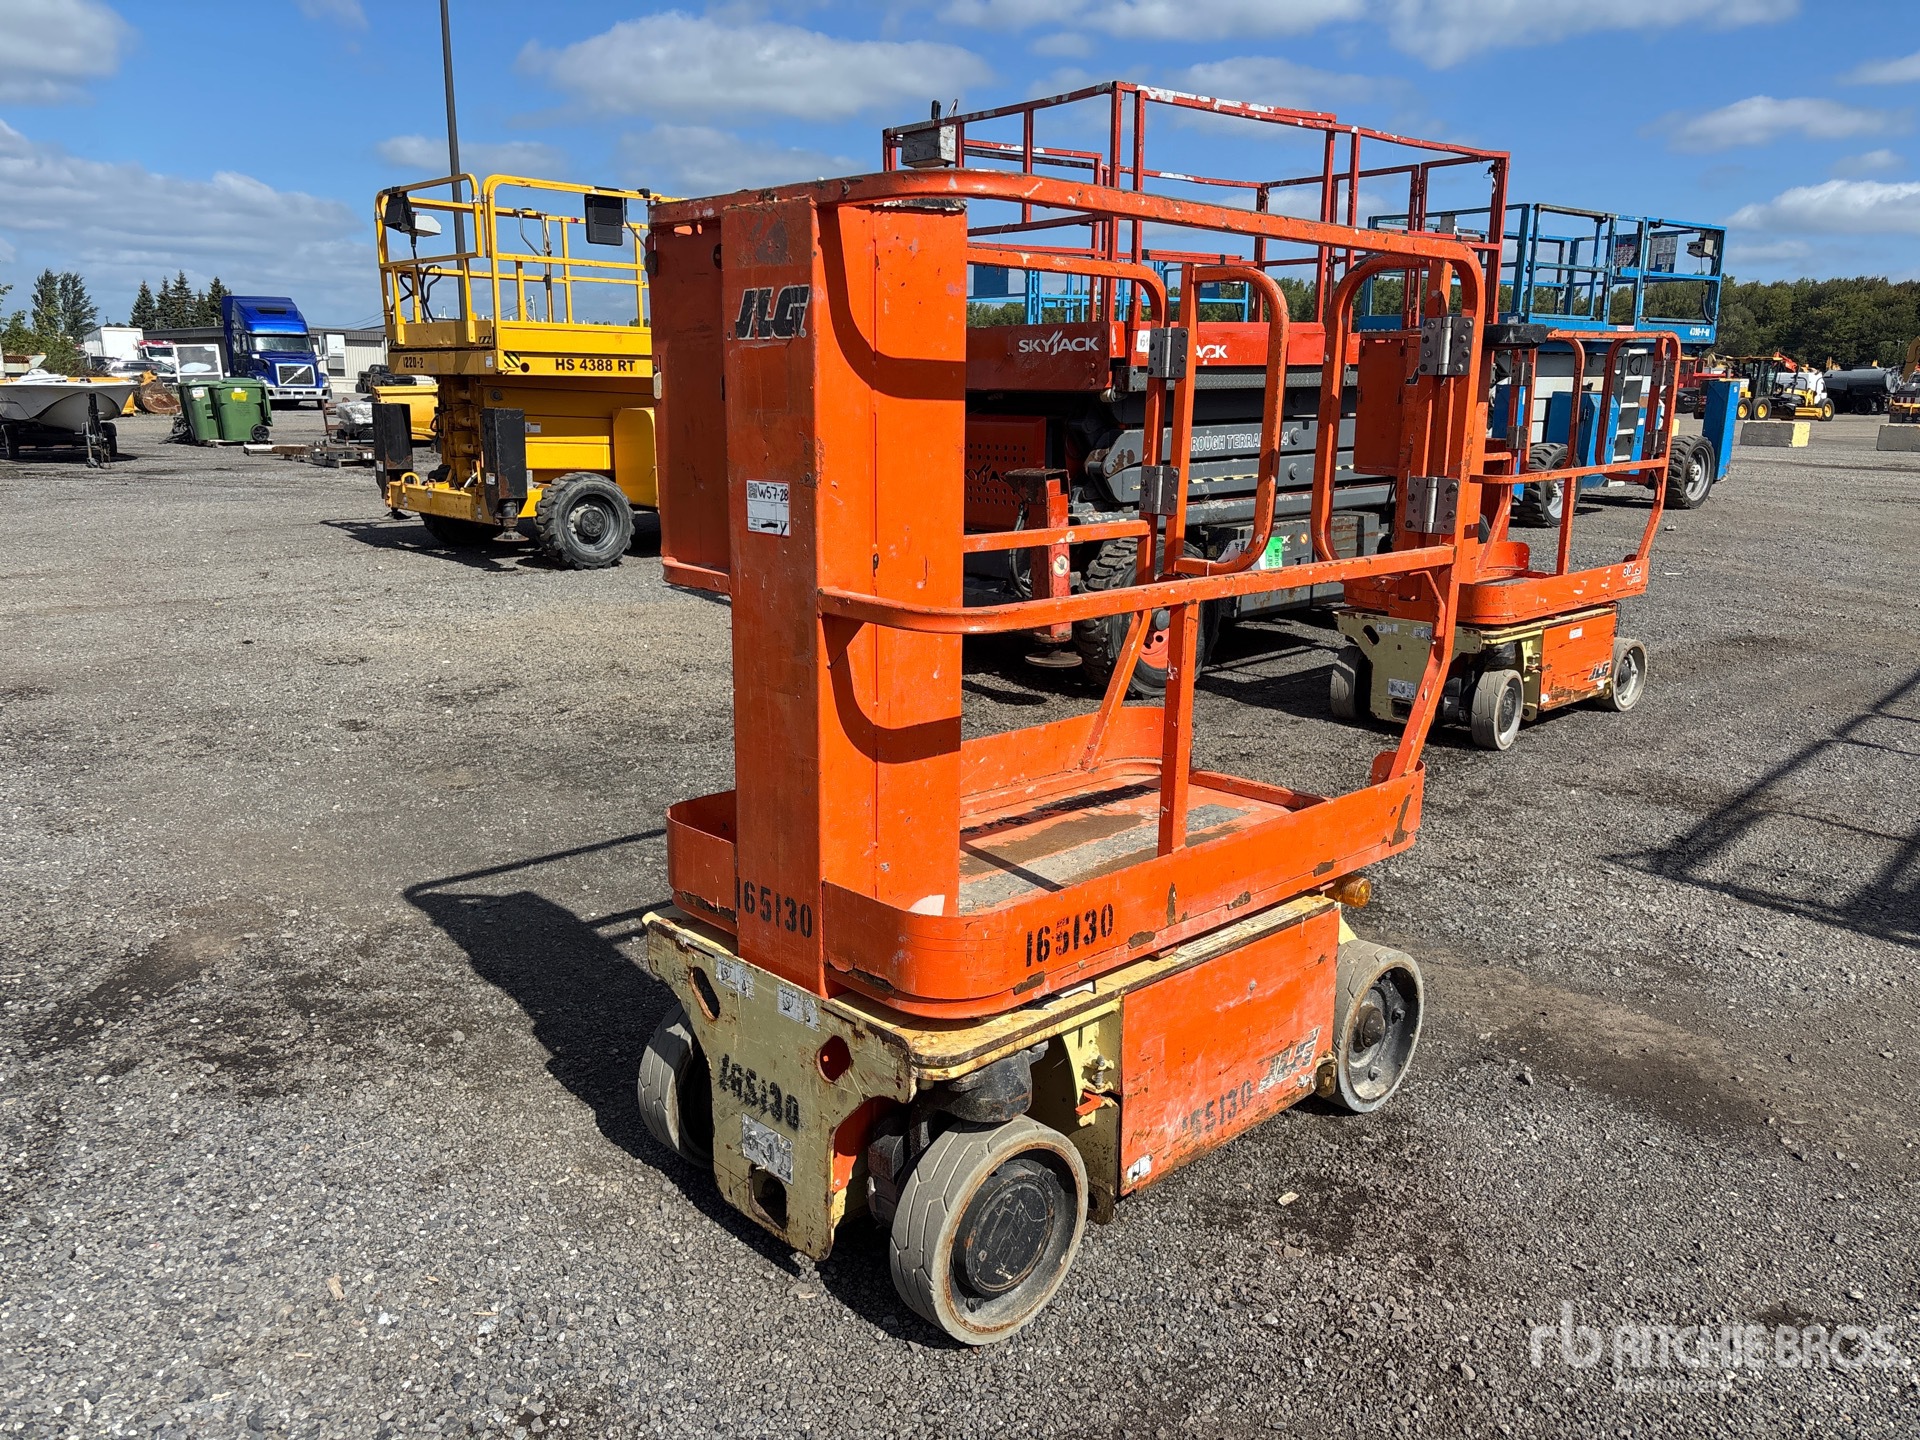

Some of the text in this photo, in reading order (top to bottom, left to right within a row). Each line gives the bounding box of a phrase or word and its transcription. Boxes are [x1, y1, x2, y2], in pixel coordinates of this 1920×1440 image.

[735, 284, 810, 340] JLG
[1018, 330, 1100, 356] SKYJACK
[555, 358, 637, 373] HS 4388 RT
[1190, 435, 1226, 452] ROUGH
[736, 876, 813, 938] 165130
[1025, 903, 1114, 968] 165130
